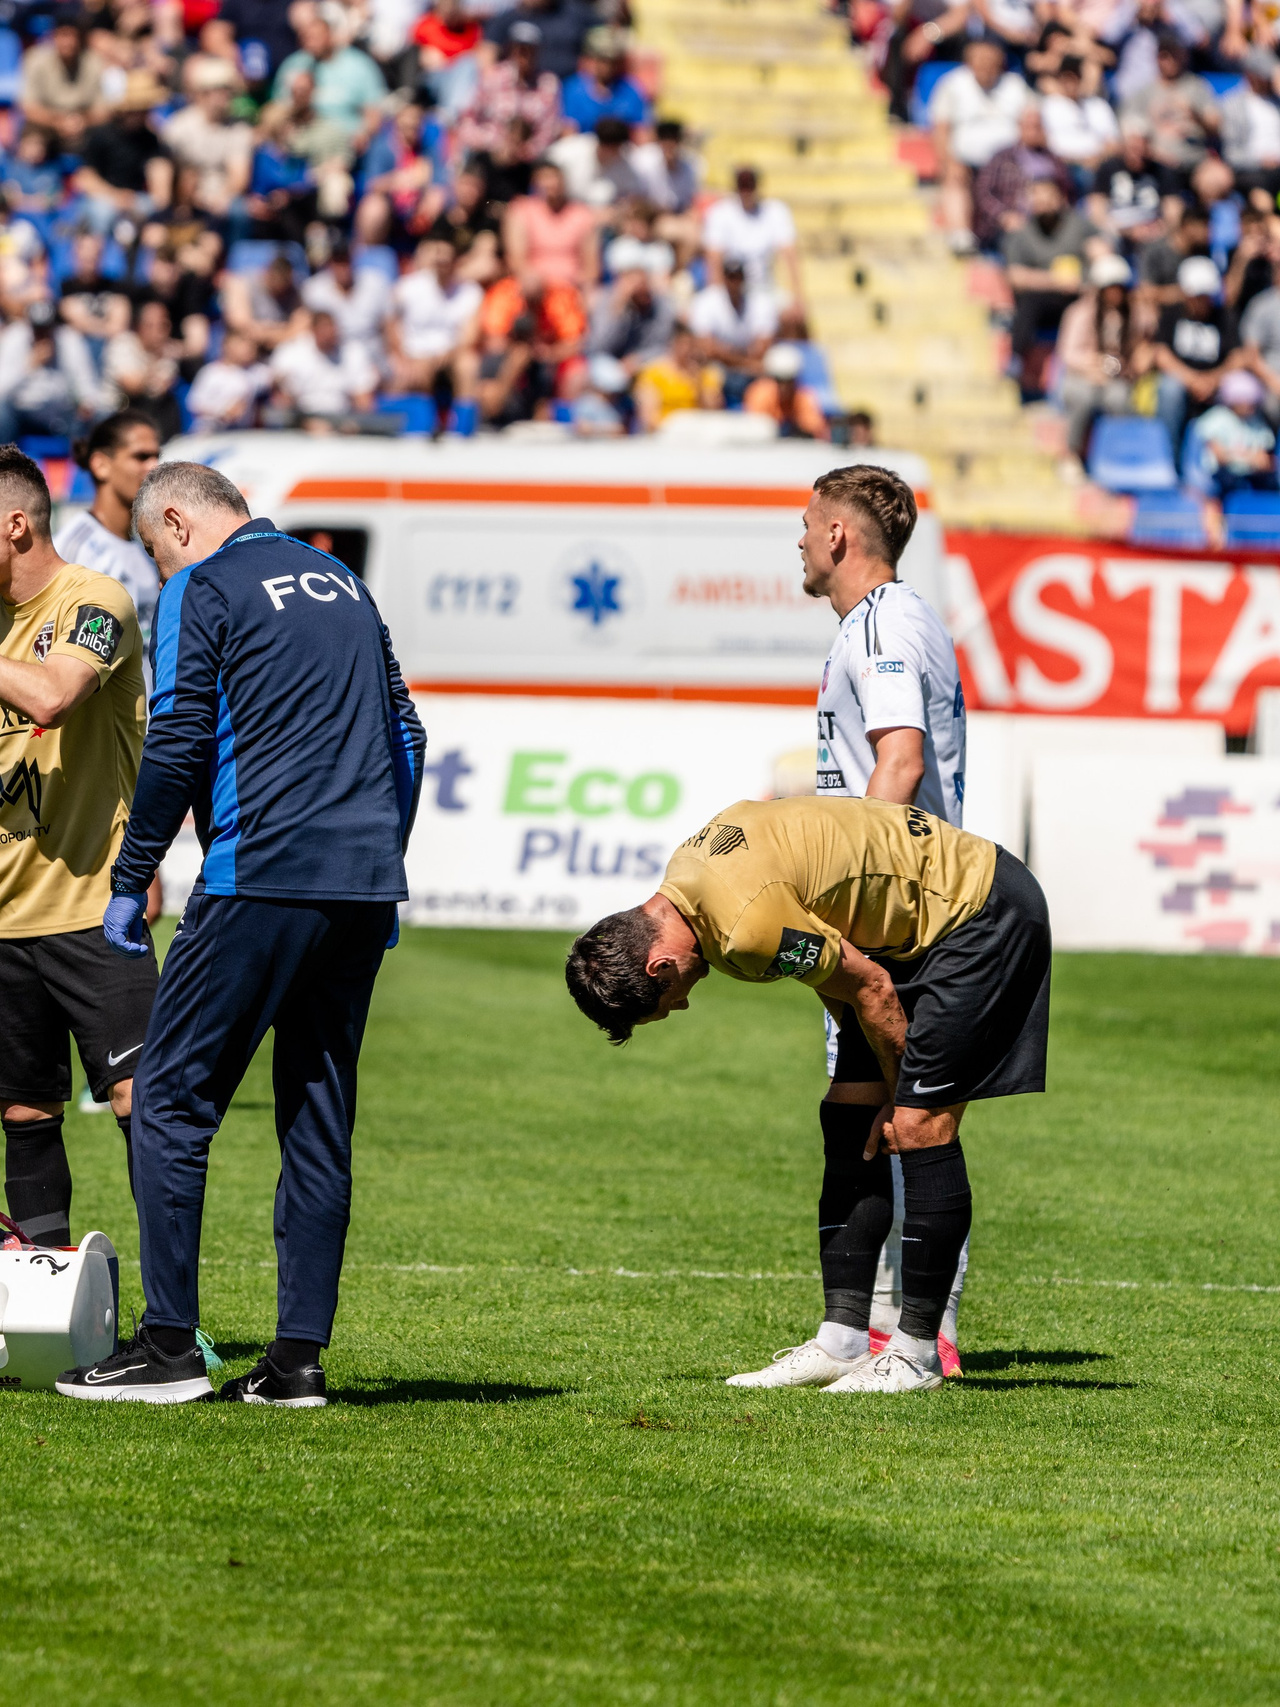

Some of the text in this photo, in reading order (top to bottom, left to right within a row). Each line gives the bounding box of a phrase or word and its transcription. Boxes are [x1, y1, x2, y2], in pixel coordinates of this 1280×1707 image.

[261, 572, 361, 611] FCV
[670, 574, 812, 608] AMBUL
[502, 748, 684, 820] Eco
[35, 824, 50, 837] TV
[517, 826, 664, 879] Plus
